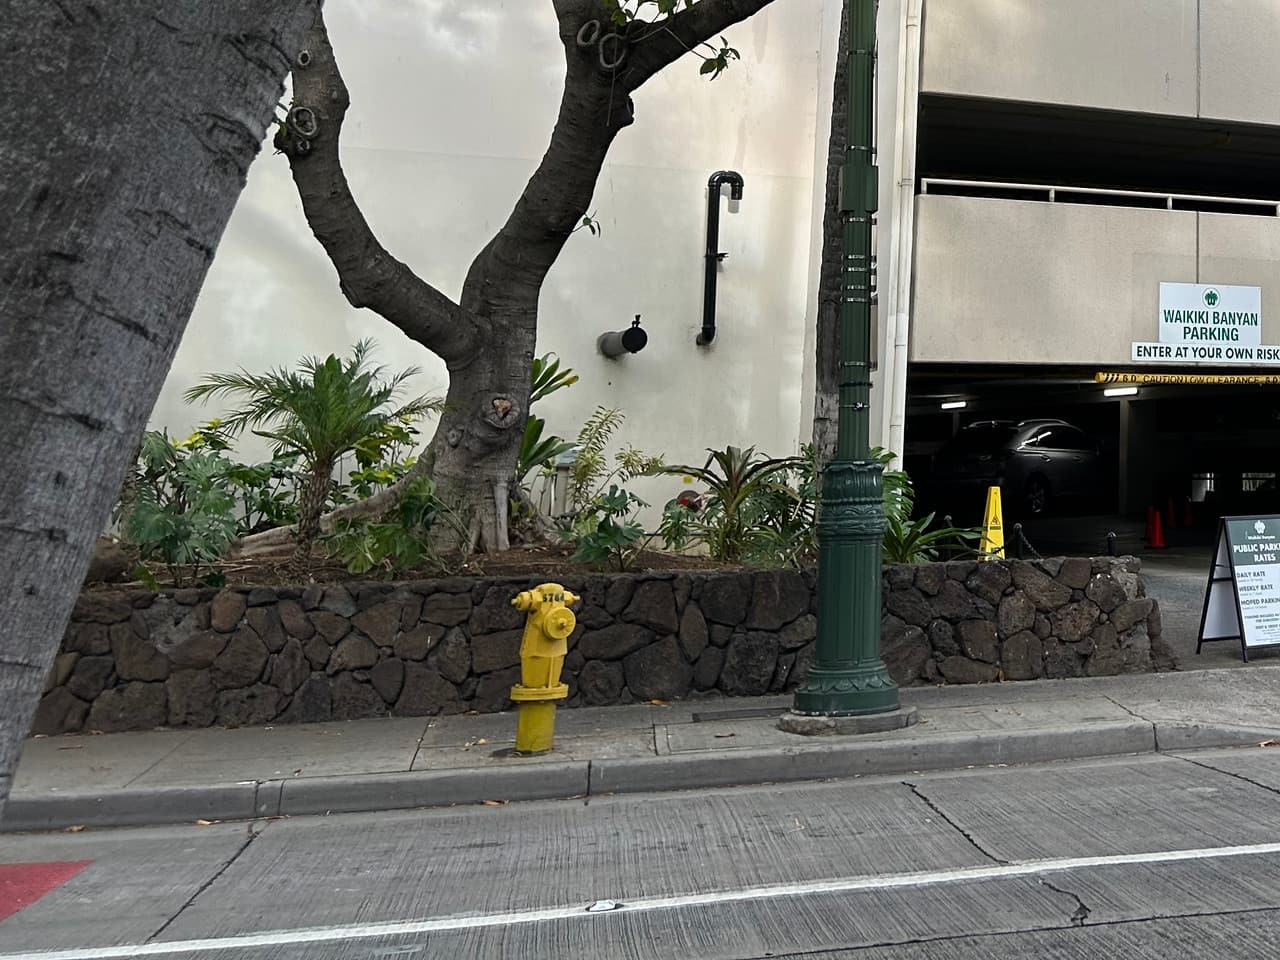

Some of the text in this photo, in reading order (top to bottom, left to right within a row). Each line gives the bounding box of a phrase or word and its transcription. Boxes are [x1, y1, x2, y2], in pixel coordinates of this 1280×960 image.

[1163, 309, 1258, 326] WAIKIKI BANYAN
[1183, 326, 1239, 342] PARKING
[1136, 345, 1280, 360] ENTER AT YOUR OWN RISK
[1143, 374, 1184, 384] CAUTION
[1206, 375, 1260, 385] CLEARANCE
[1233, 543, 1259, 553] PUBLIC
[1254, 553, 1276, 562] RATES
